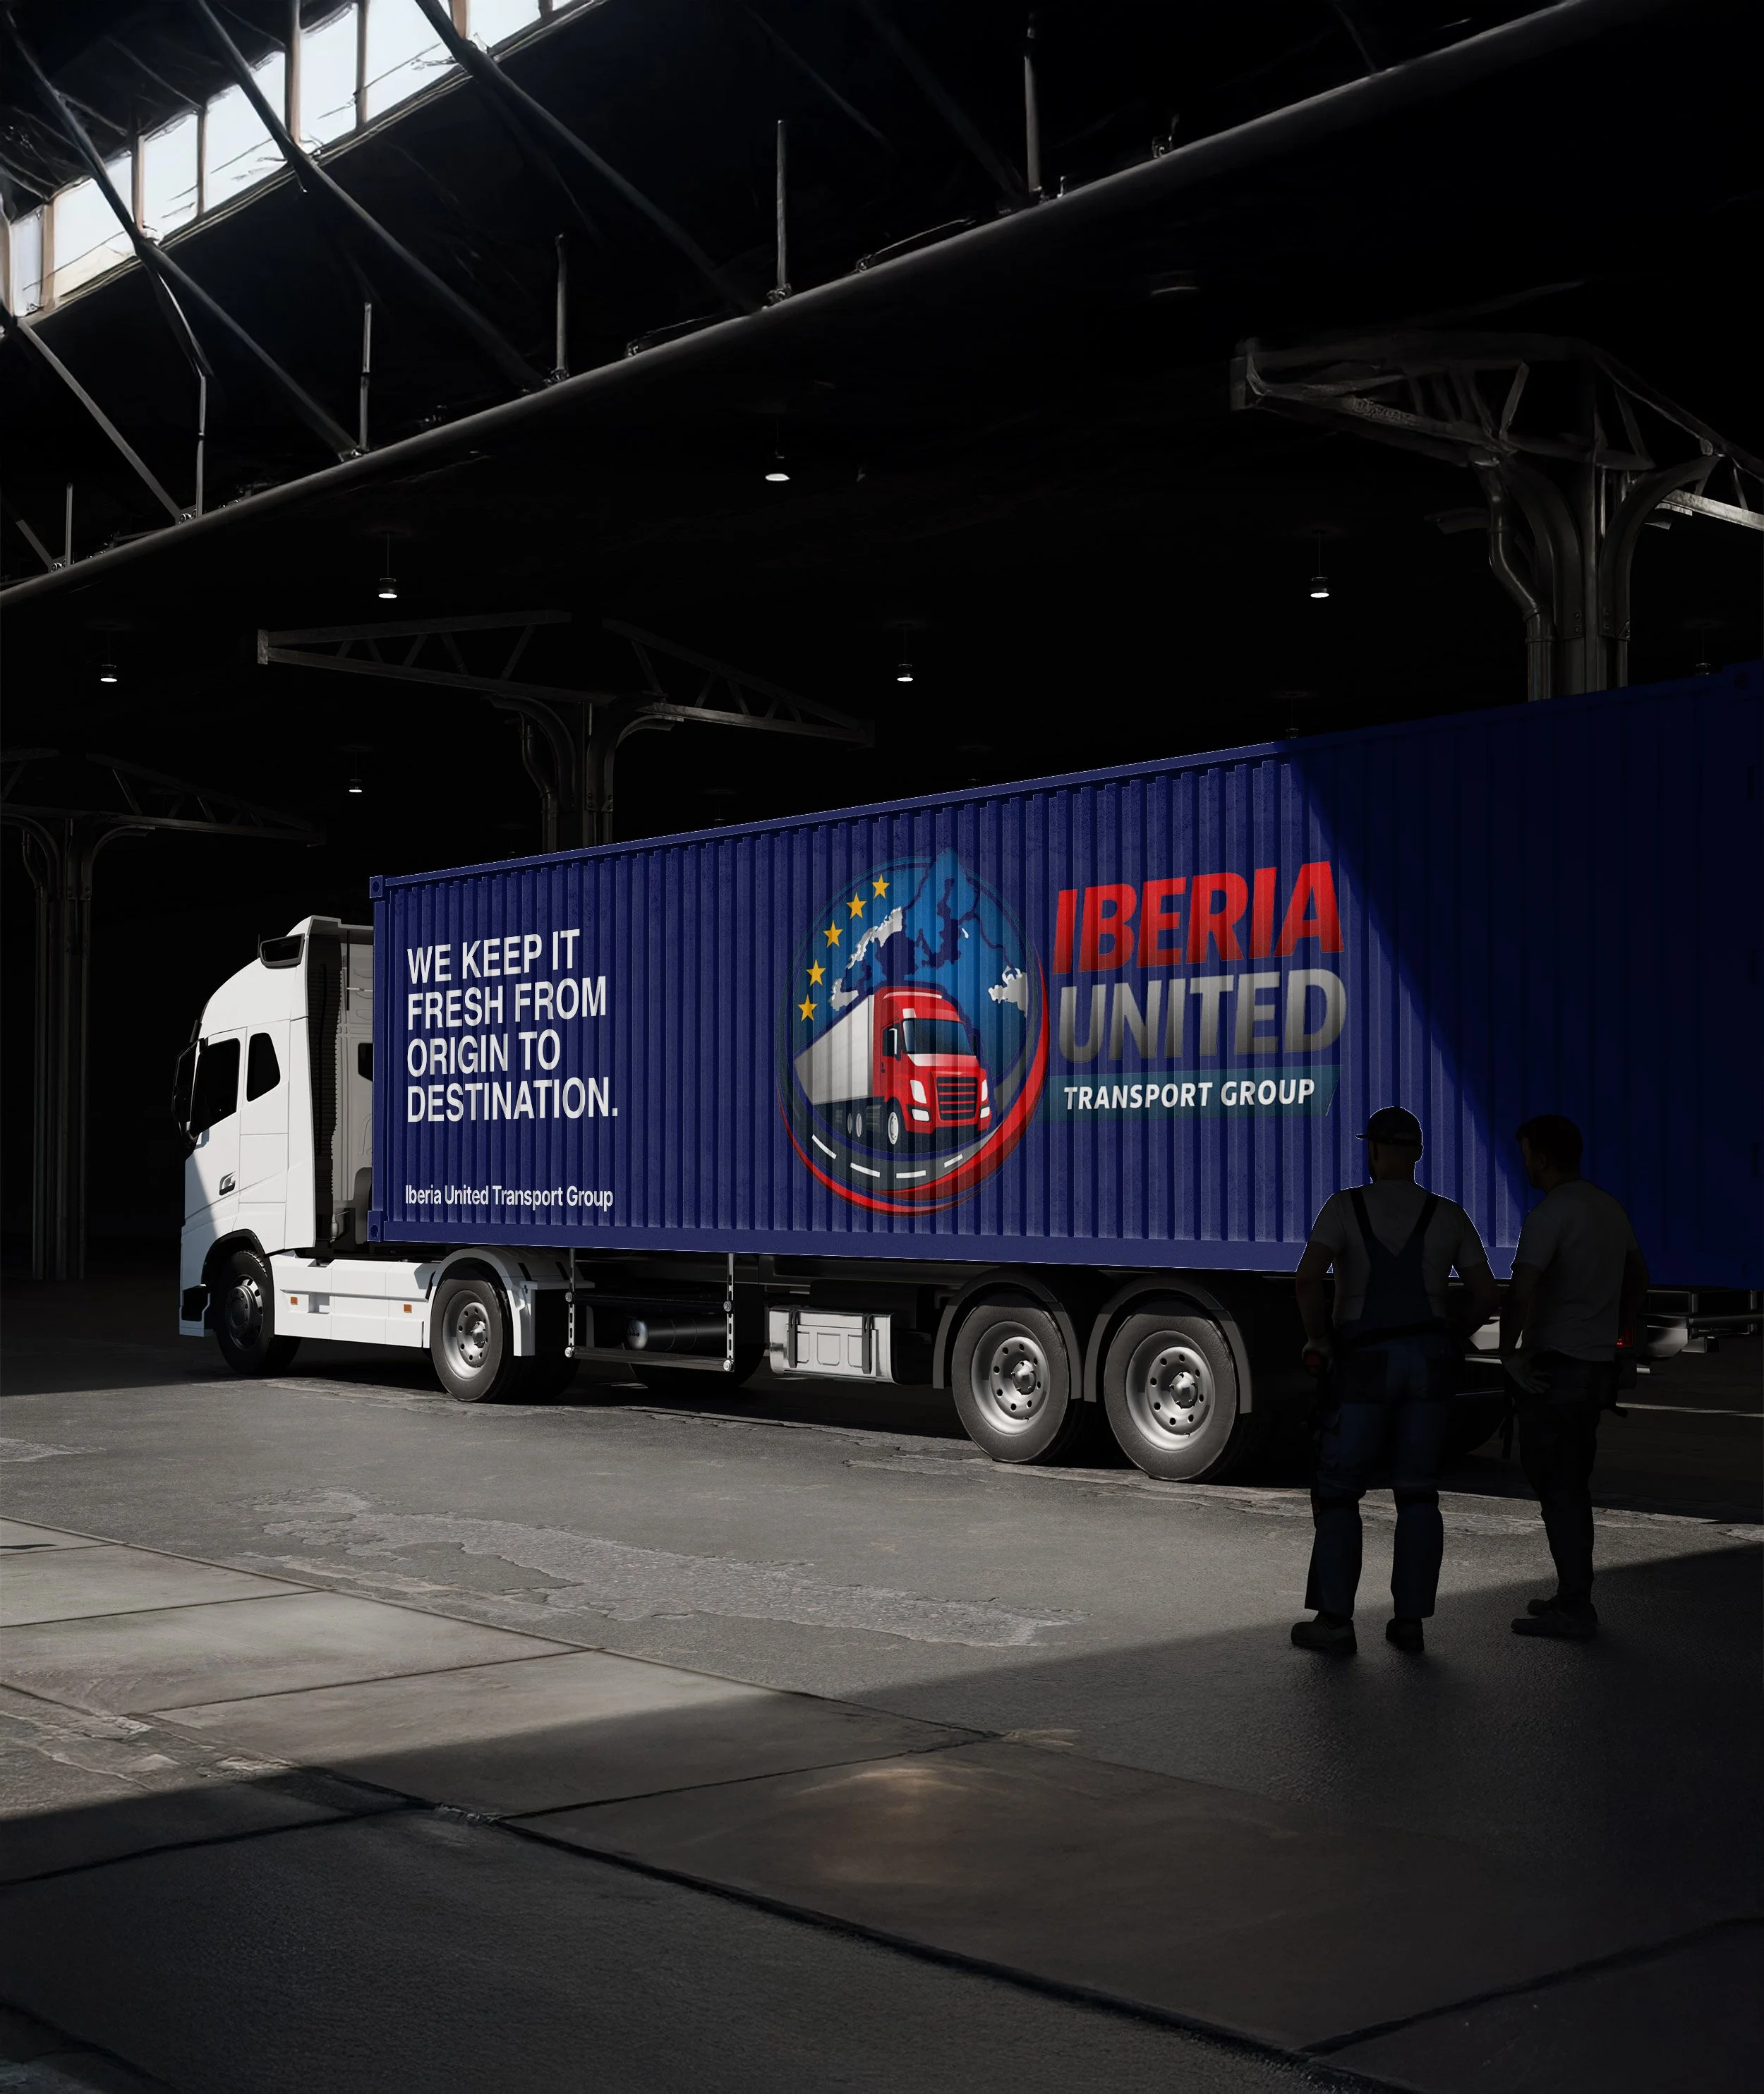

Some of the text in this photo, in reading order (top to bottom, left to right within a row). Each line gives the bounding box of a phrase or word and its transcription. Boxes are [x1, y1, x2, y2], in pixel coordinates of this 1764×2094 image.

[1053, 861, 1344, 974] IBERIA
[407, 928, 580, 984] WE KEEP IT
[407, 976, 606, 1030] FRESH FROM
[1059, 968, 1347, 1063] UNITED
[407, 1029, 561, 1077] ORIGIN TO
[407, 1077, 618, 1122] DESTINATION.
[1063, 1078, 1315, 1110] TRANSPORT GROUP
[405, 1185, 614, 1212] Iberia United Transport Group
